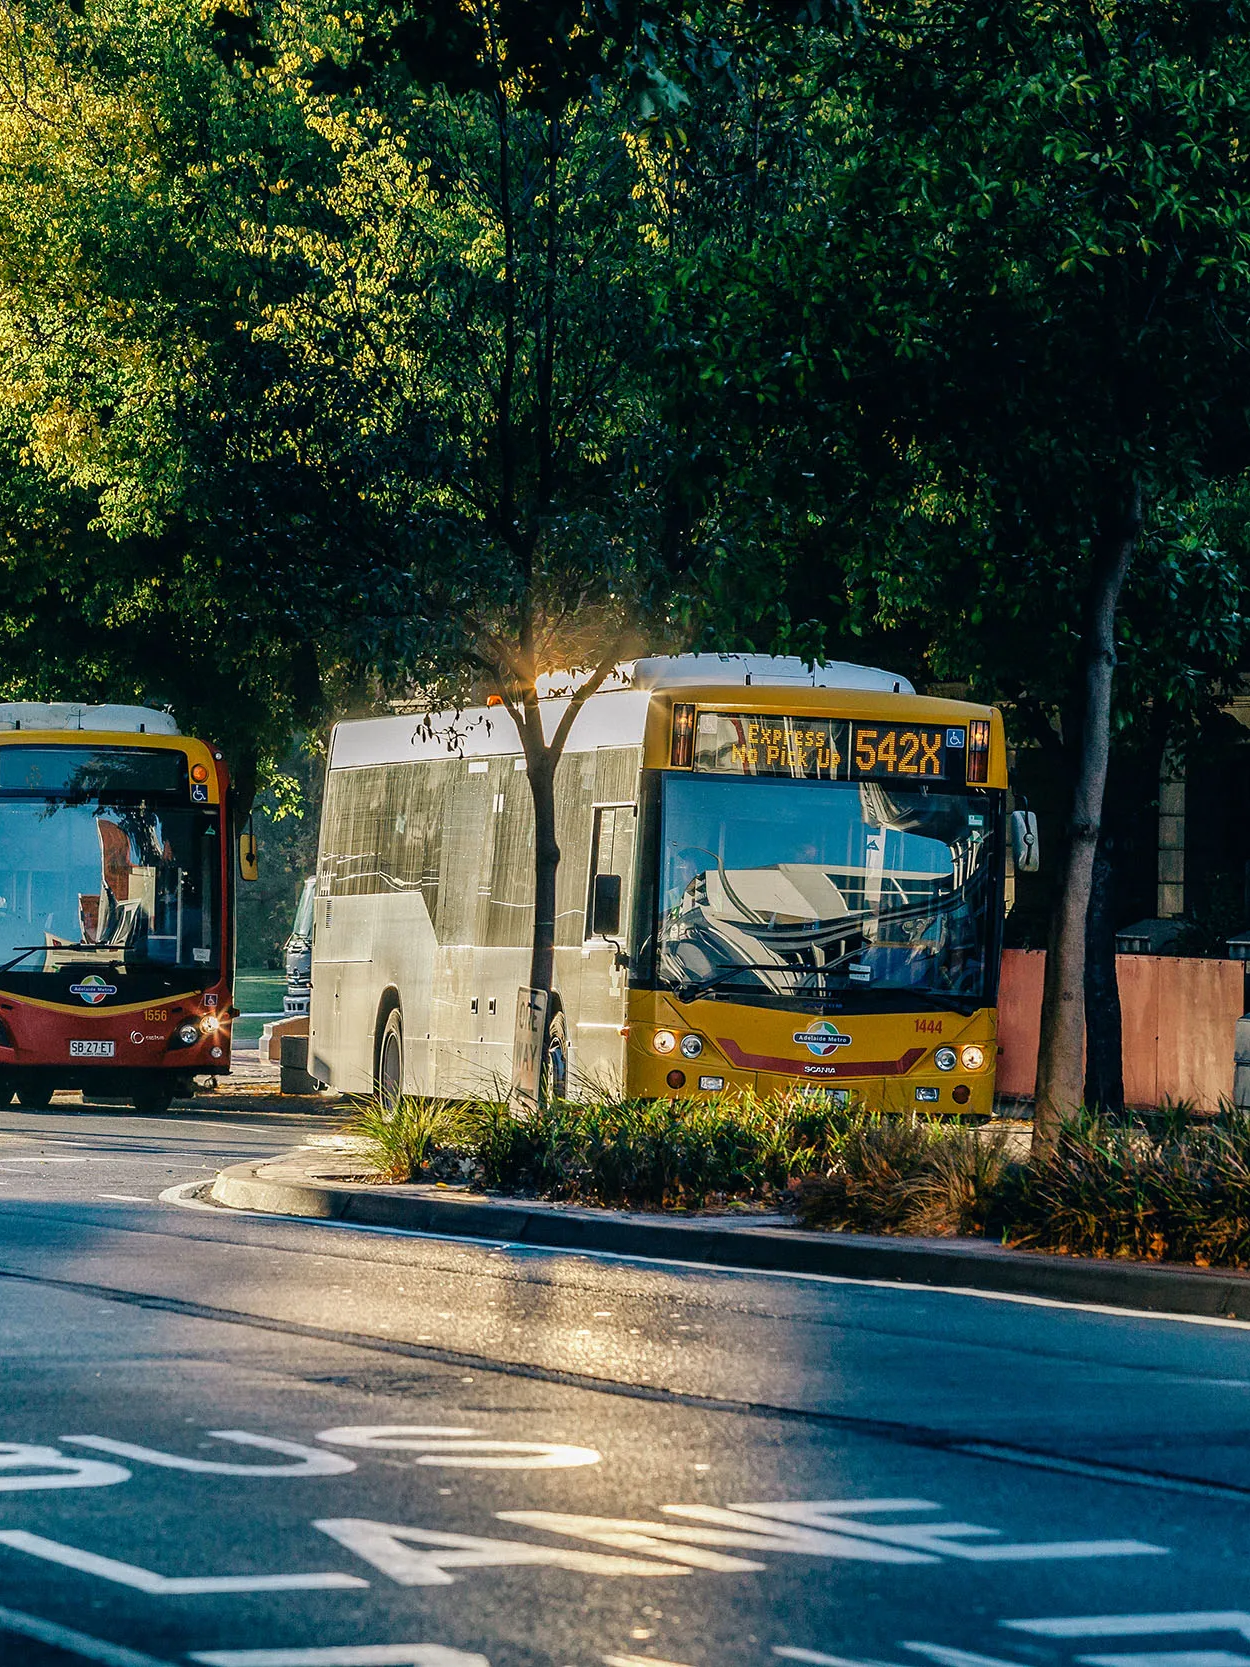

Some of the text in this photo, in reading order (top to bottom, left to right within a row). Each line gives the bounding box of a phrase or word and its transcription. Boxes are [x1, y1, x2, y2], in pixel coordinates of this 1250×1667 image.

[748, 724, 941, 774] Express 542X
[731, 743, 841, 769] No Pick Up
[144, 1009, 167, 1021] 1556
[914, 1019, 942, 1034] 1444
[798, 1034, 826, 1042] Adelaide
[804, 1065, 836, 1074] SCANIA
